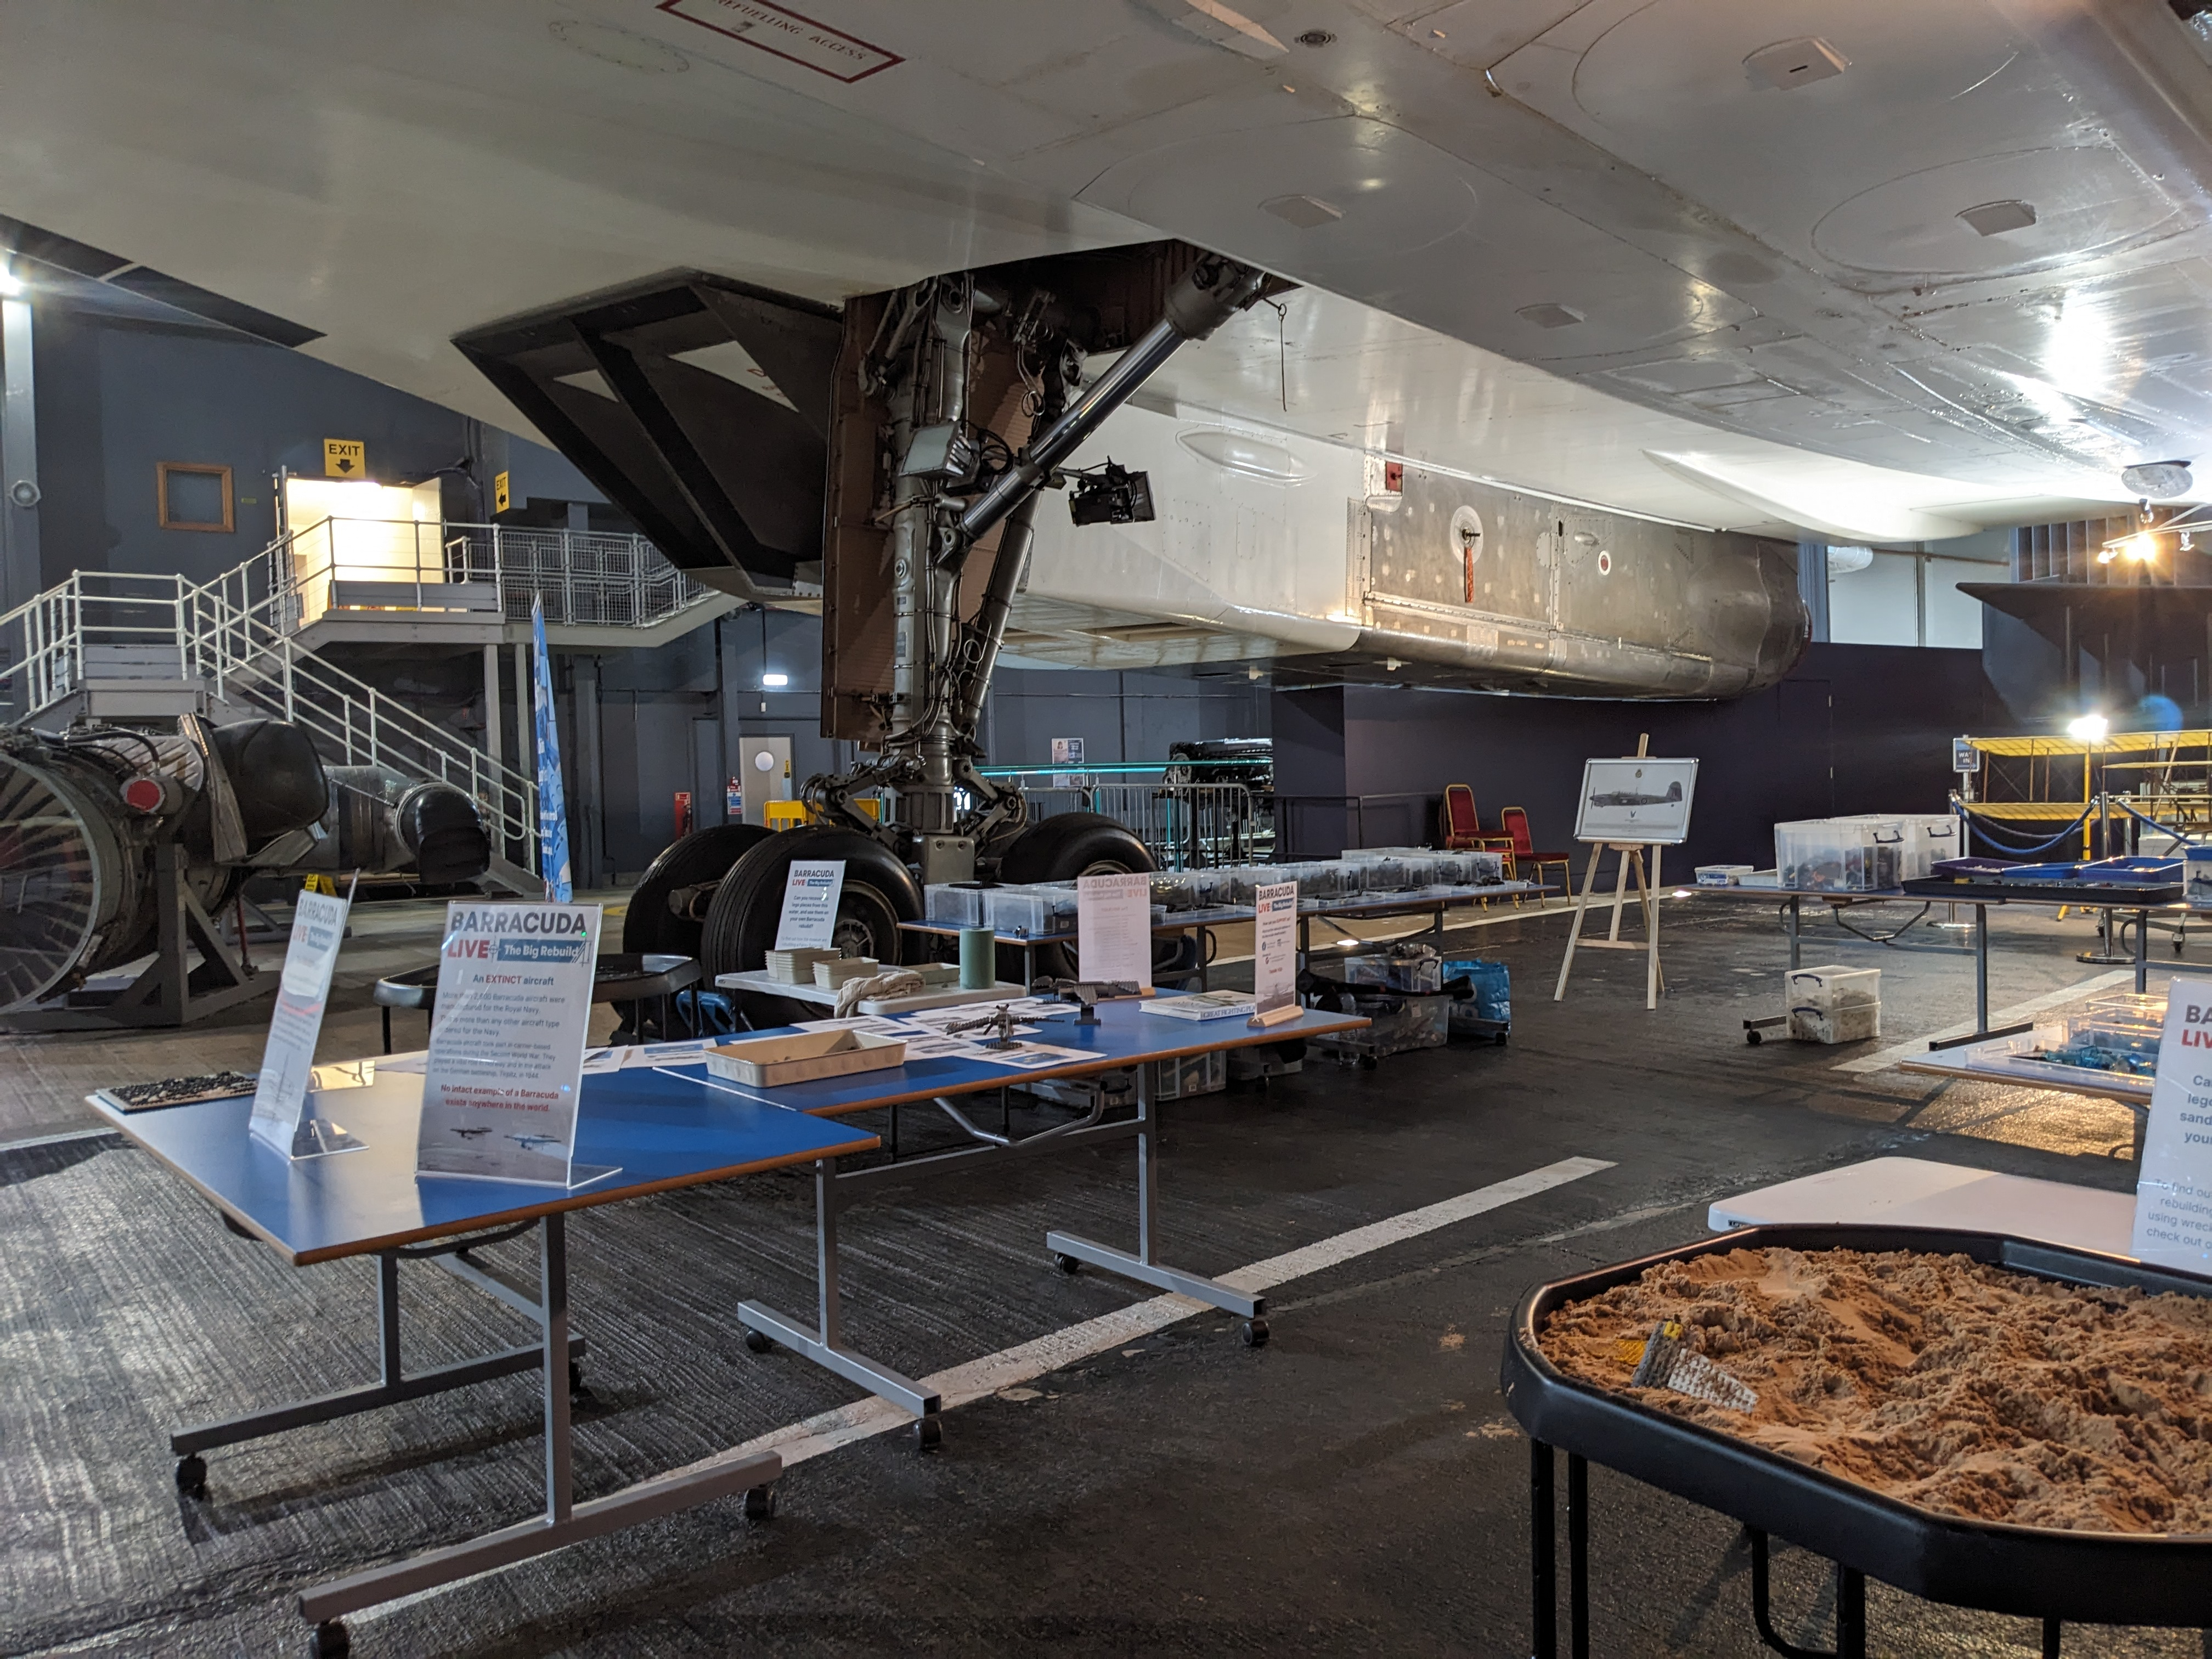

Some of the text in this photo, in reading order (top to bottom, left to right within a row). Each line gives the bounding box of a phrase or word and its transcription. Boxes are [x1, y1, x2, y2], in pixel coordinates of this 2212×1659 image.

[808, 34, 866, 60] ACCESS
[329, 443, 360, 456] EXIT
[496, 476, 506, 490] EXIT
[794, 870, 834, 878] BARRACUDA
[1259, 885, 1294, 901] BARRACUDA
[298, 899, 338, 927] BARRACUDA
[1258, 902, 1271, 913] LIVE
[451, 911, 586, 934] BARRACUDA
[447, 939, 580, 959] LIVE The Big Rebuild
[473, 974, 554, 985] An EXTINCT aircraft
[505, 1005, 522, 1014] Royal
[1221, 1007, 1246, 1016] FIGHTING
[2193, 1075, 2212, 1087] Ca
[452, 1084, 472, 1093] intact
[473, 1087, 504, 1096] example
[521, 1089, 559, 1099] Barracuda
[445, 1098, 466, 1107] exists
[469, 1100, 504, 1109] anywhere
[505, 1101, 512, 1109] in
[514, 1102, 525, 1110] the
[2155, 1178, 2212, 1198] To find ou
[2148, 1211, 2177, 1227] using
[2146, 1227, 2180, 1242] check
[2183, 1236, 2202, 1246] out
